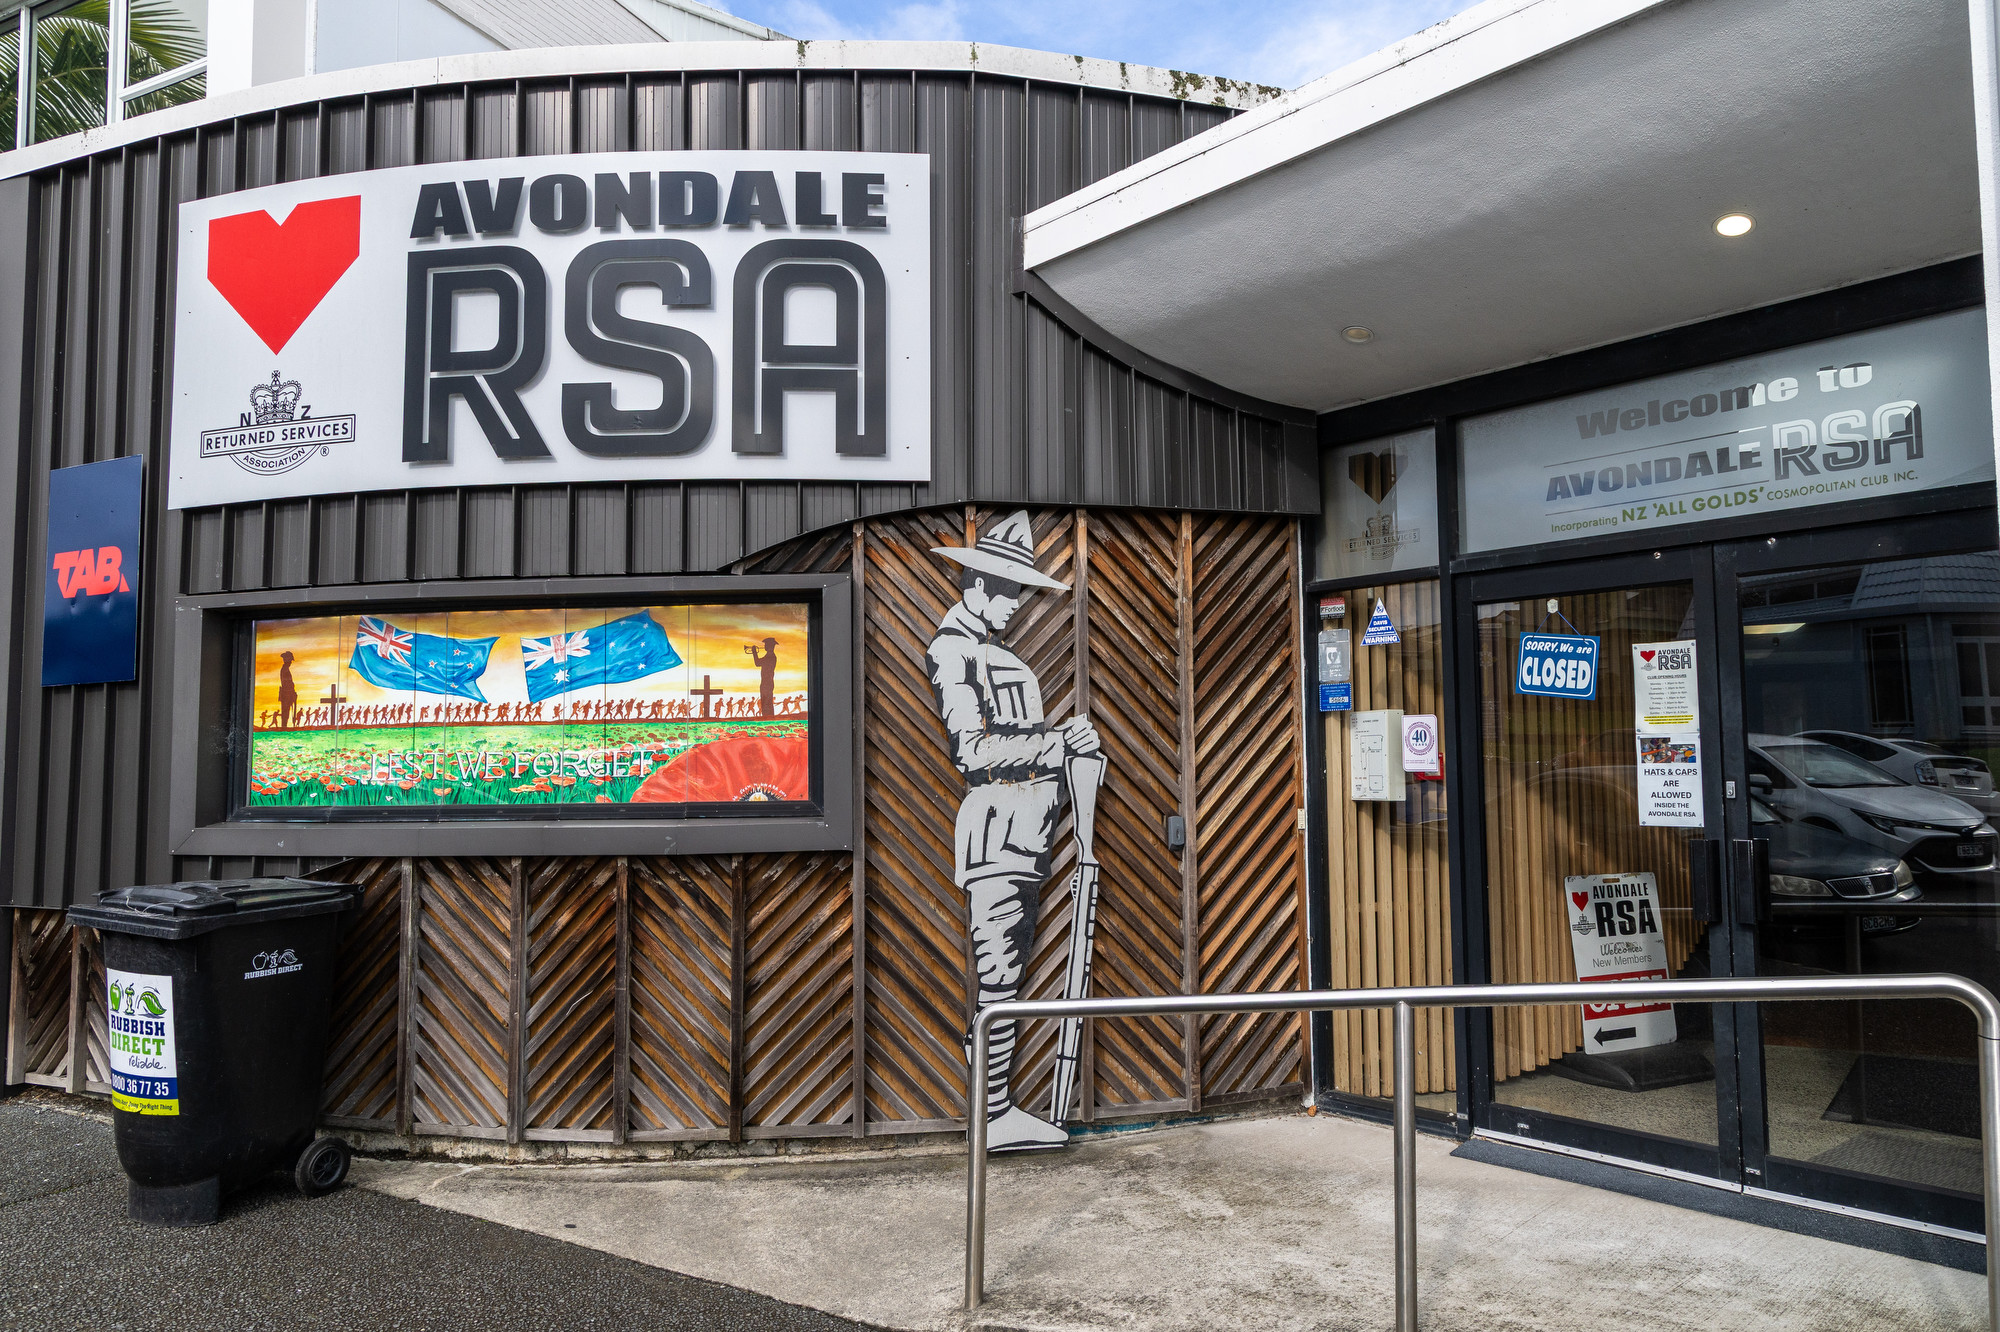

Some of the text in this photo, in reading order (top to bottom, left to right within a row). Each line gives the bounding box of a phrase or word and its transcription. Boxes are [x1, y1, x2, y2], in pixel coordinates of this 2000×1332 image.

[409, 170, 887, 239] AVONDALE
[402, 239, 887, 463] RSA
[1576, 361, 1873, 440] Welcome to
[240, 404, 312, 428] N Z
[205, 422, 349, 451] RETURNED SERVICES
[243, 447, 306, 469] ASSOCIATION
[1546, 399, 1924, 502] AVONDALE RSA
[1551, 516, 1618, 533] Incorporating
[1622, 506, 1648, 522] NZ
[1766, 479, 1856, 501] COSMOPOLITAN
[1860, 473, 1889, 487] CLUB
[1893, 470, 1919, 482] INC.
[53, 545, 122, 599] TAB
[1365, 635, 1398, 644] WARNING
[1525, 640, 1592, 654] SORRY, We are
[1522, 656, 1591, 690] CLOSED
[1658, 654, 1692, 671] RSA
[1412, 729, 1428, 743] 40
[370, 749, 656, 781] LEST WE FORGET
[1675, 768, 1698, 776] CAPS
[1651, 791, 1692, 799] ALLOWED
[1592, 882, 1649, 900] AVONDALE
[1594, 899, 1658, 938] RSA
[244, 963, 303, 980] RUBBISH DIRECT
[1592, 954, 1653, 968] New Members
[111, 1014, 165, 1037] RUBBISH
[111, 1031, 165, 1056] DIRECT
[126, 1078, 138, 1094] 36
[139, 1080, 151, 1096] 77
[154, 1081, 169, 1096] 35
[160, 1103, 173, 1111] Thing
